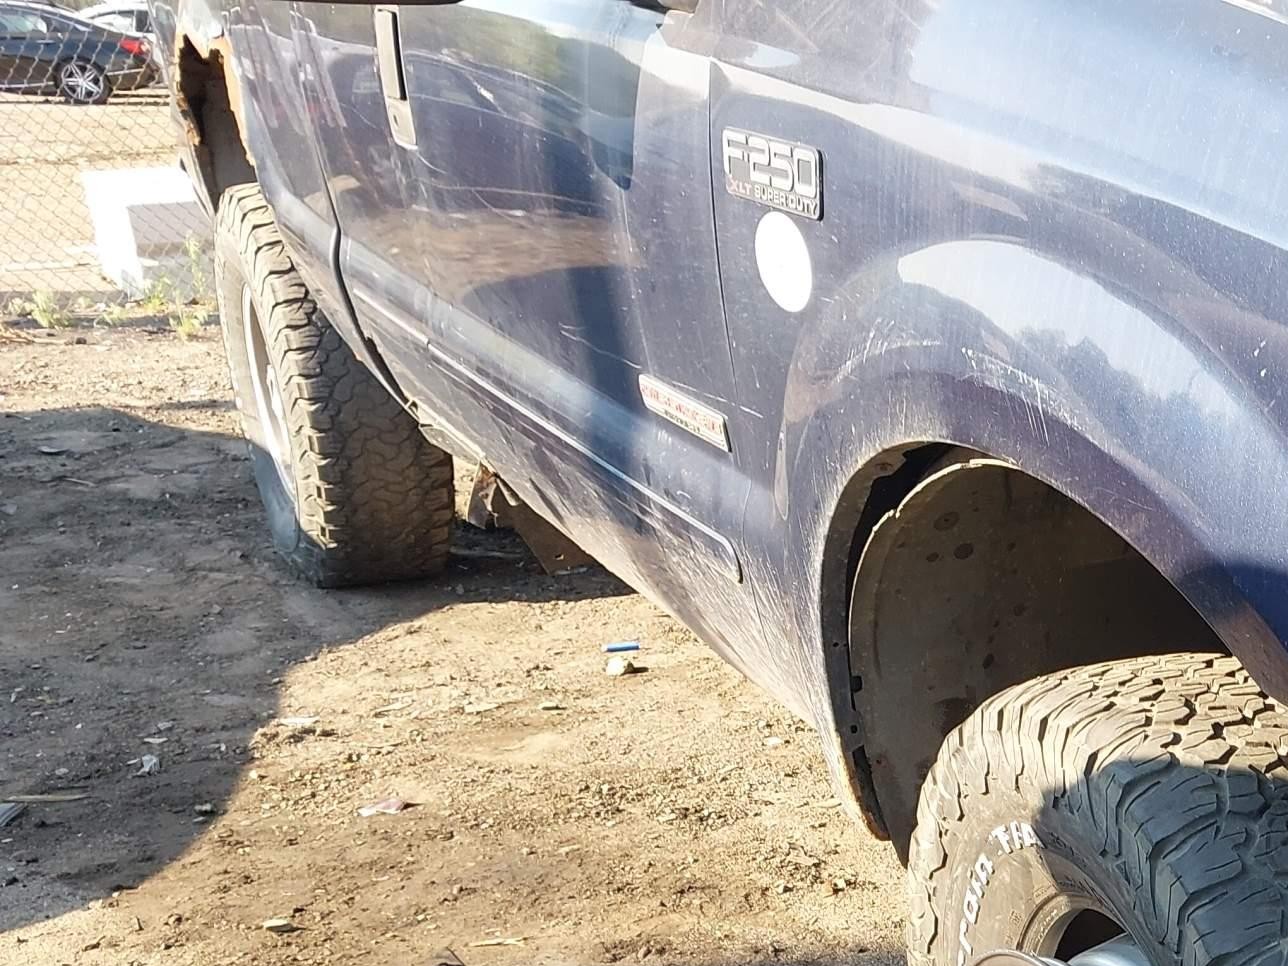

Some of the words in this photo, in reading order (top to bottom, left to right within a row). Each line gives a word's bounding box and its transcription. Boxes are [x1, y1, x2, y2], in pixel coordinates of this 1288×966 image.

[729, 177, 752, 195] XLT
[754, 184, 787, 206] SUPER
[788, 193, 817, 216] DUTY
